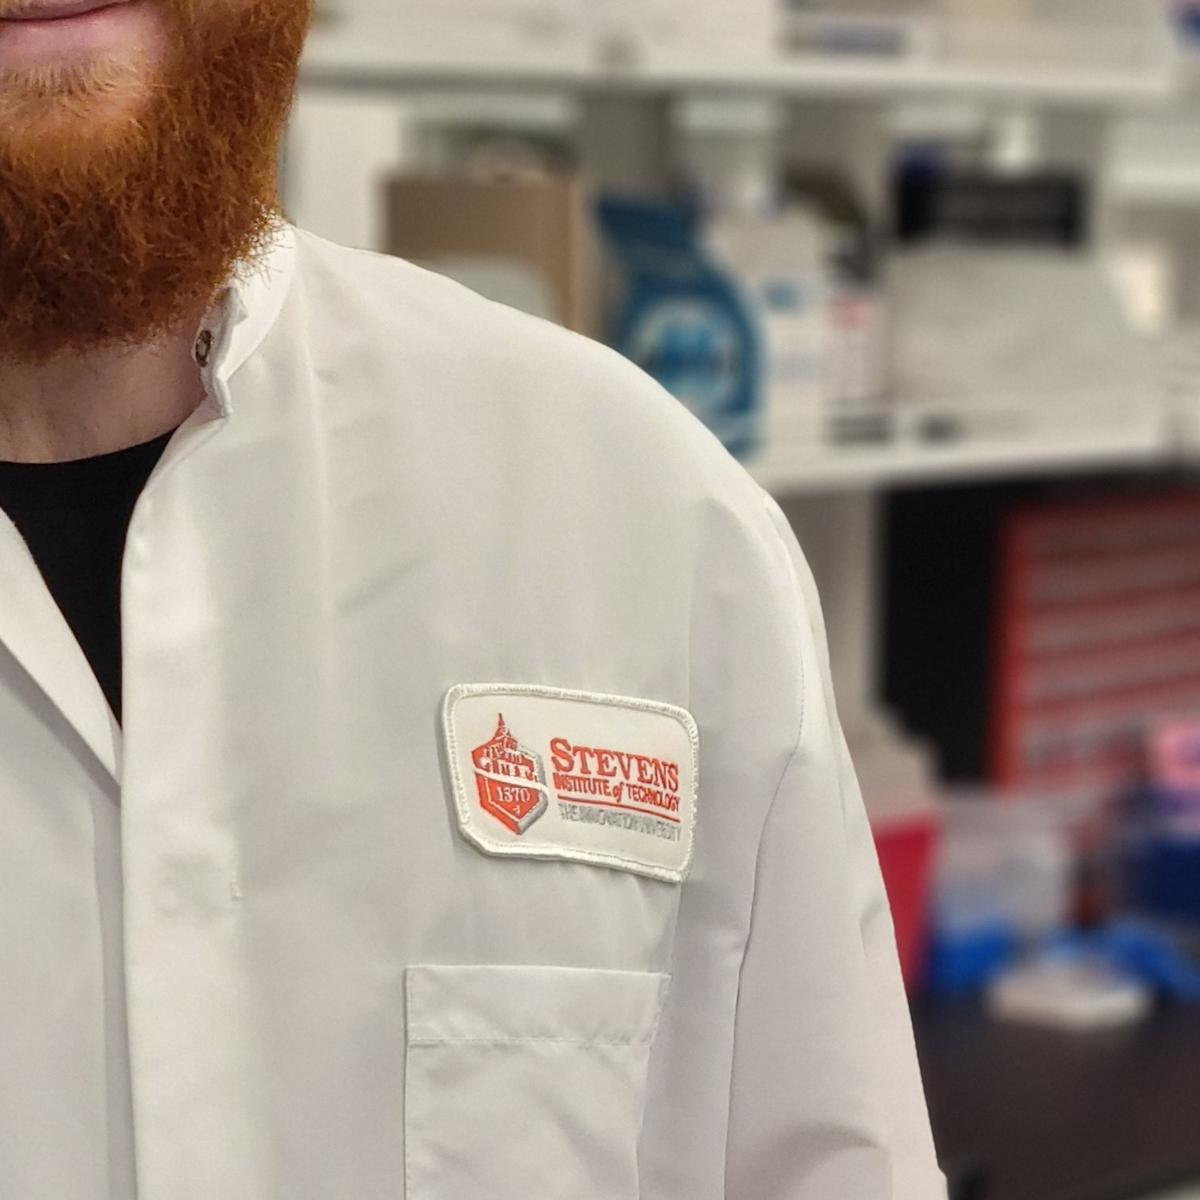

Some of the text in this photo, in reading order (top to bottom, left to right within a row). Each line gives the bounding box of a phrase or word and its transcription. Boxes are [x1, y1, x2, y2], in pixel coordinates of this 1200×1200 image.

[550, 737, 679, 793] STEVENS
[552, 772, 681, 812] INSTITUTE of TECHNOLOGY
